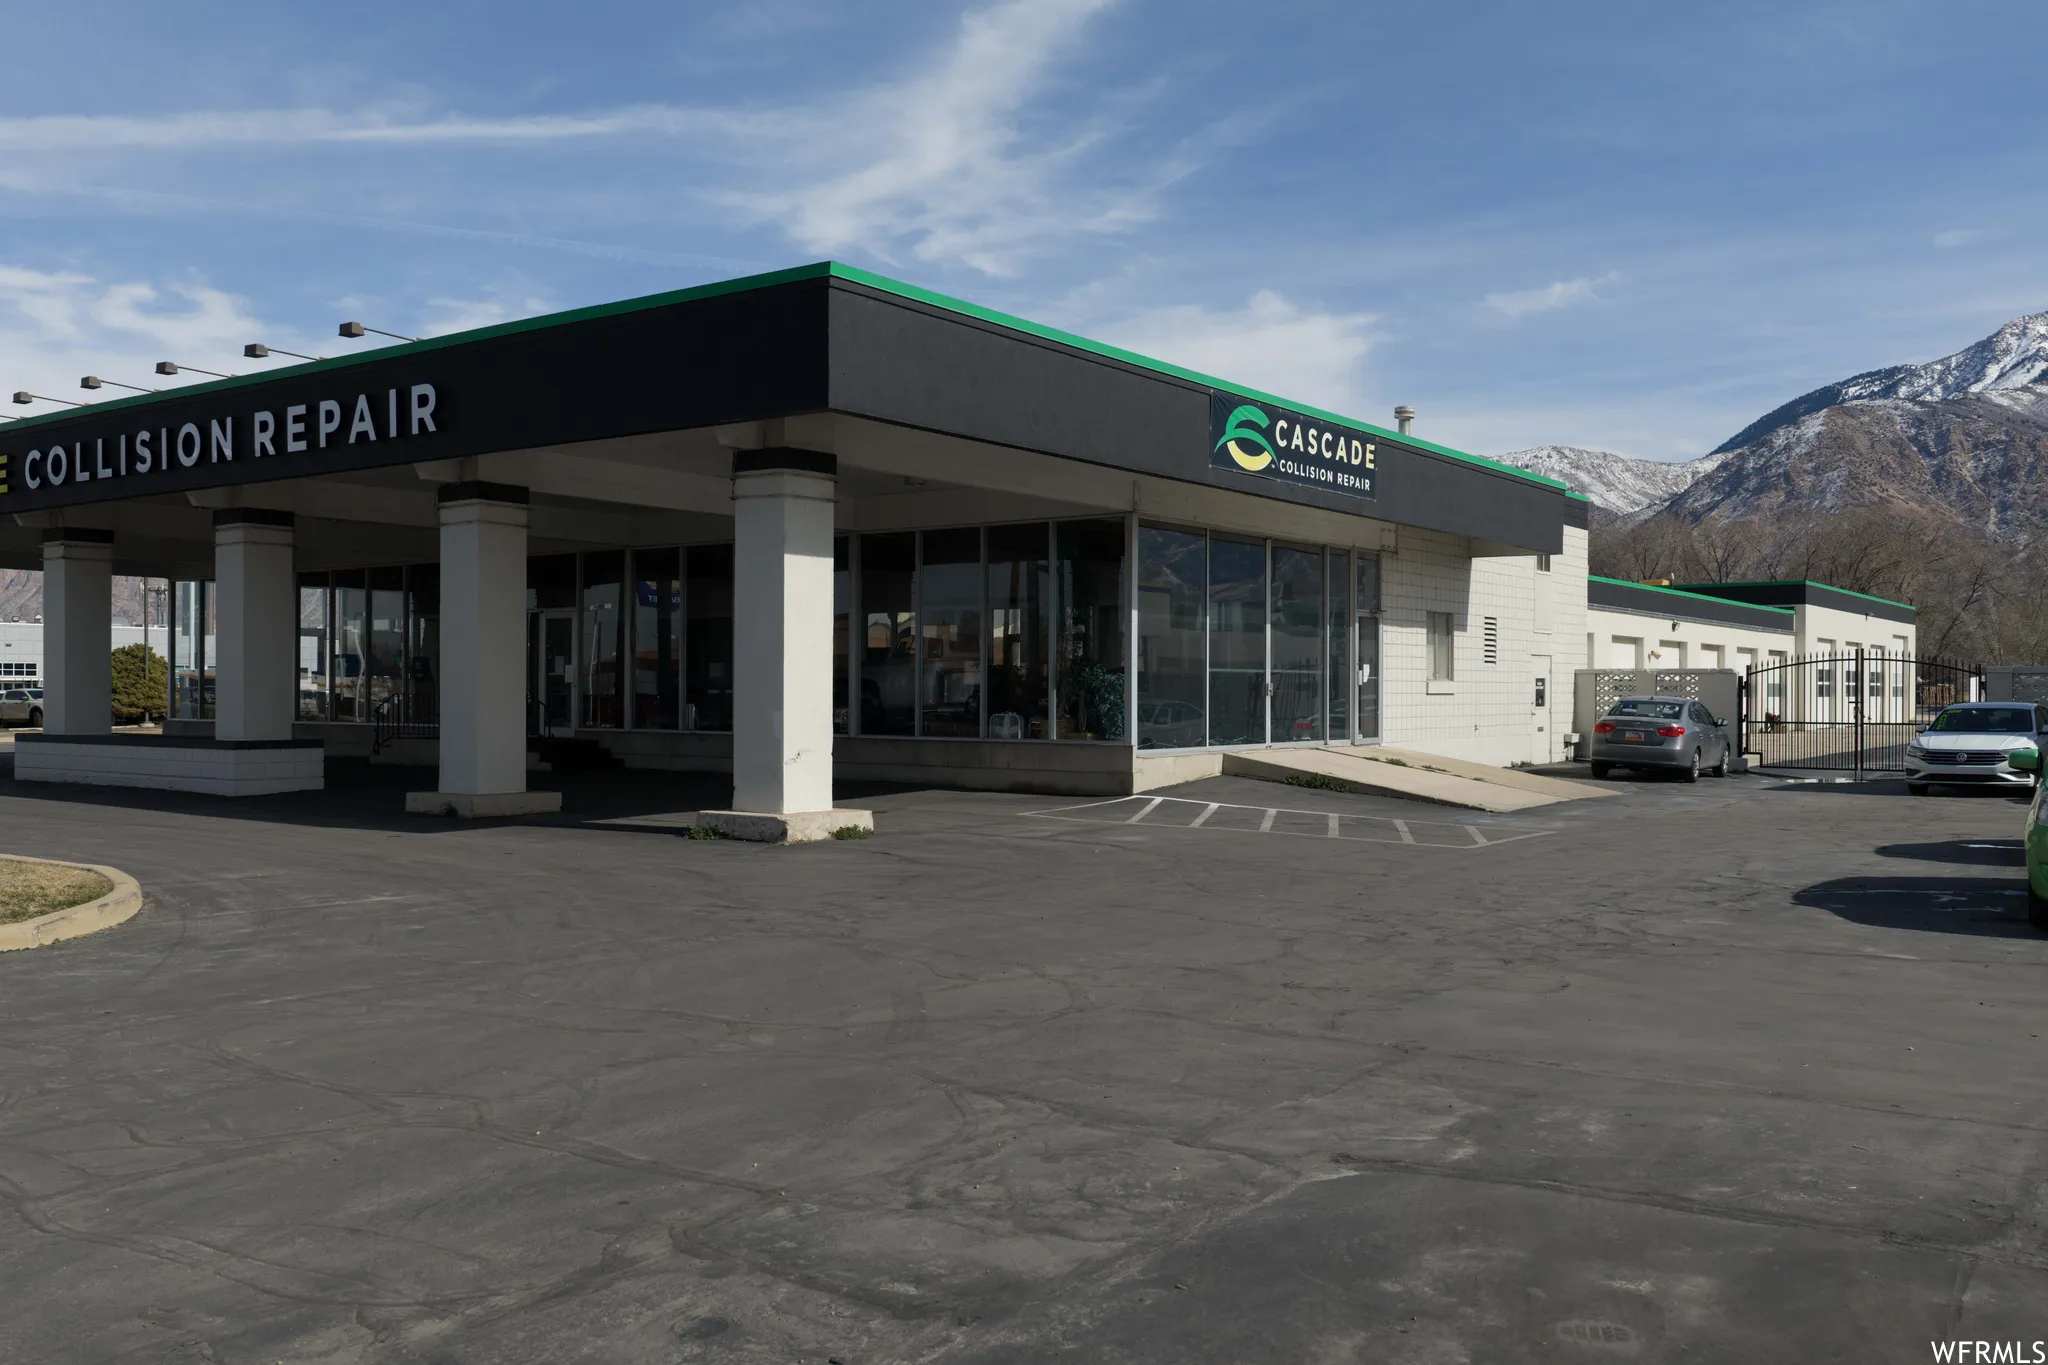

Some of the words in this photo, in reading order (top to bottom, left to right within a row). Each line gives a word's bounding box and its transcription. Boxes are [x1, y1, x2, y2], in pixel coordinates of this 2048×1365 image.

[24, 417, 233, 490] COLLISION
[254, 383, 437, 457] REPAIR
[1275, 419, 1375, 469] CASCADE
[1279, 459, 1333, 483] COLLISION
[1337, 472, 1370, 491] REPAIR
